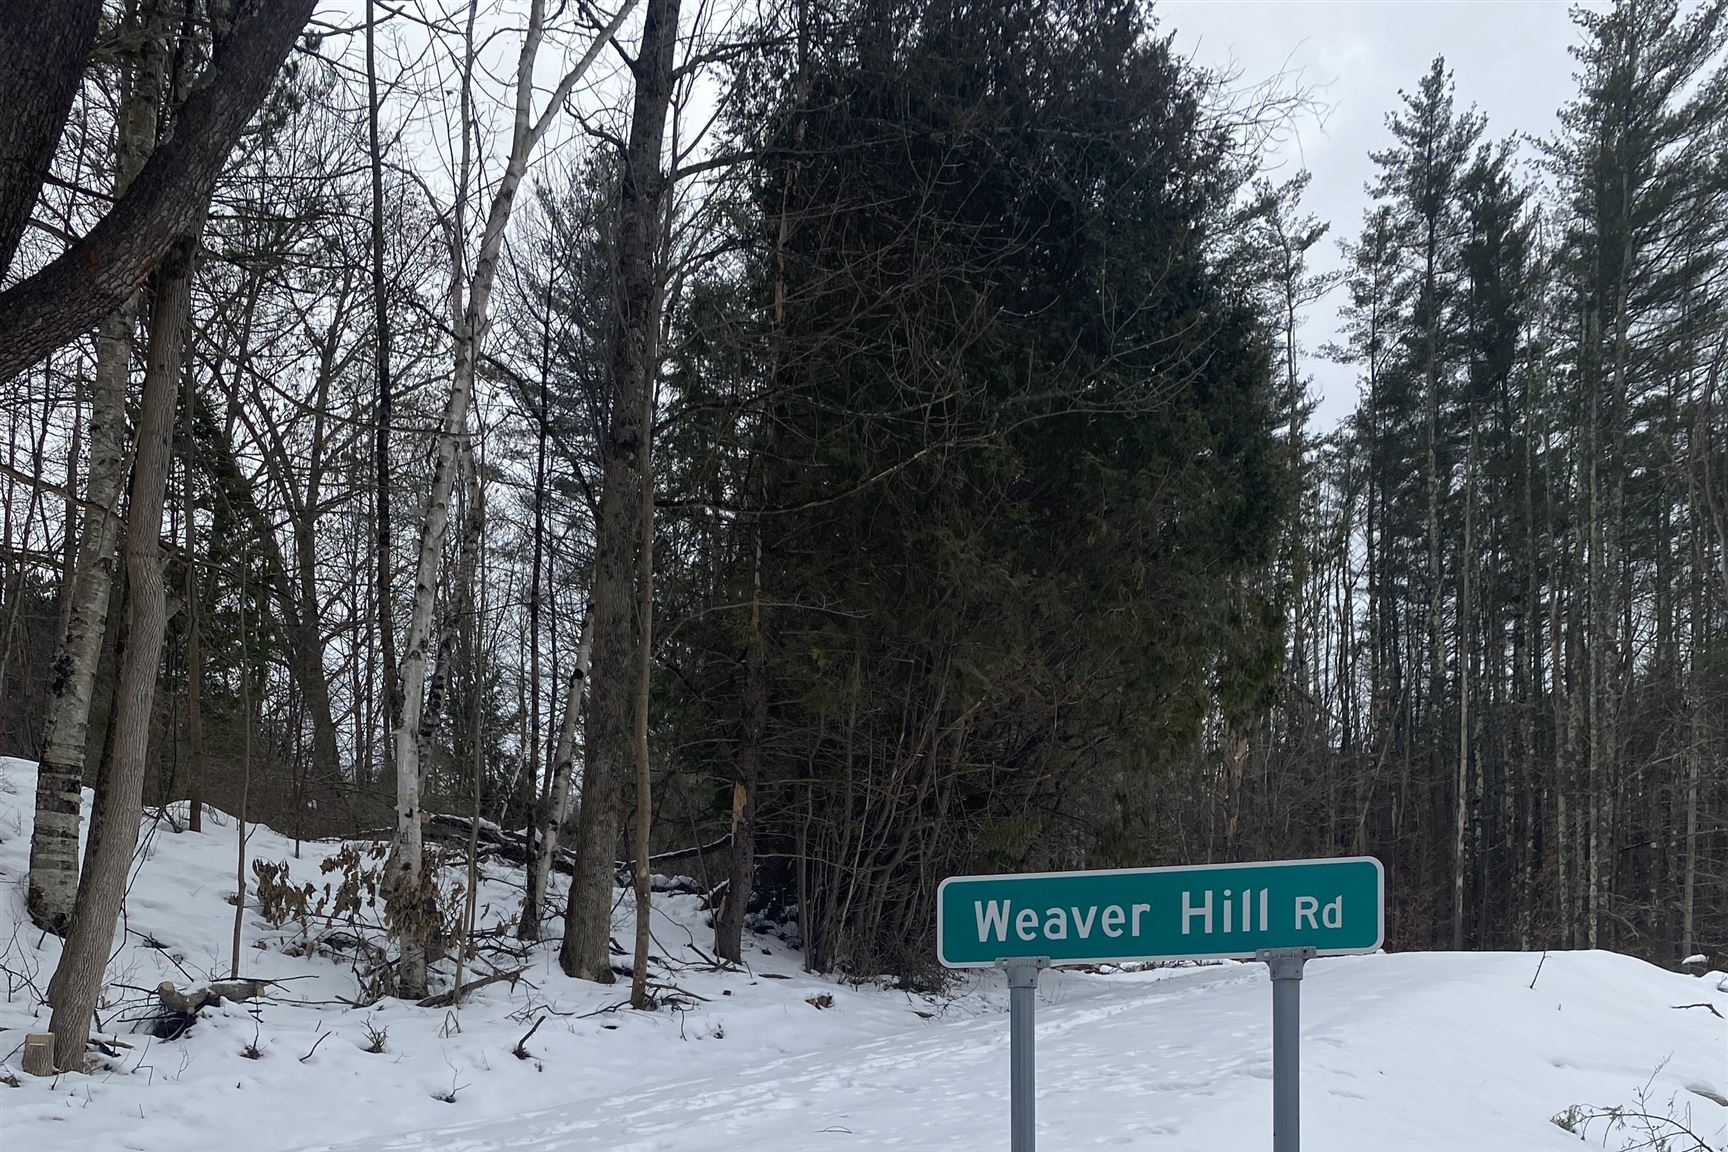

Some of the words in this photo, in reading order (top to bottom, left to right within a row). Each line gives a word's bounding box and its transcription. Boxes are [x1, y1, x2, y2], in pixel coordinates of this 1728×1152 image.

[974, 899, 1151, 942] Weaver
[1181, 888, 1269, 934] Hill
[1295, 894, 1343, 930] Rd
